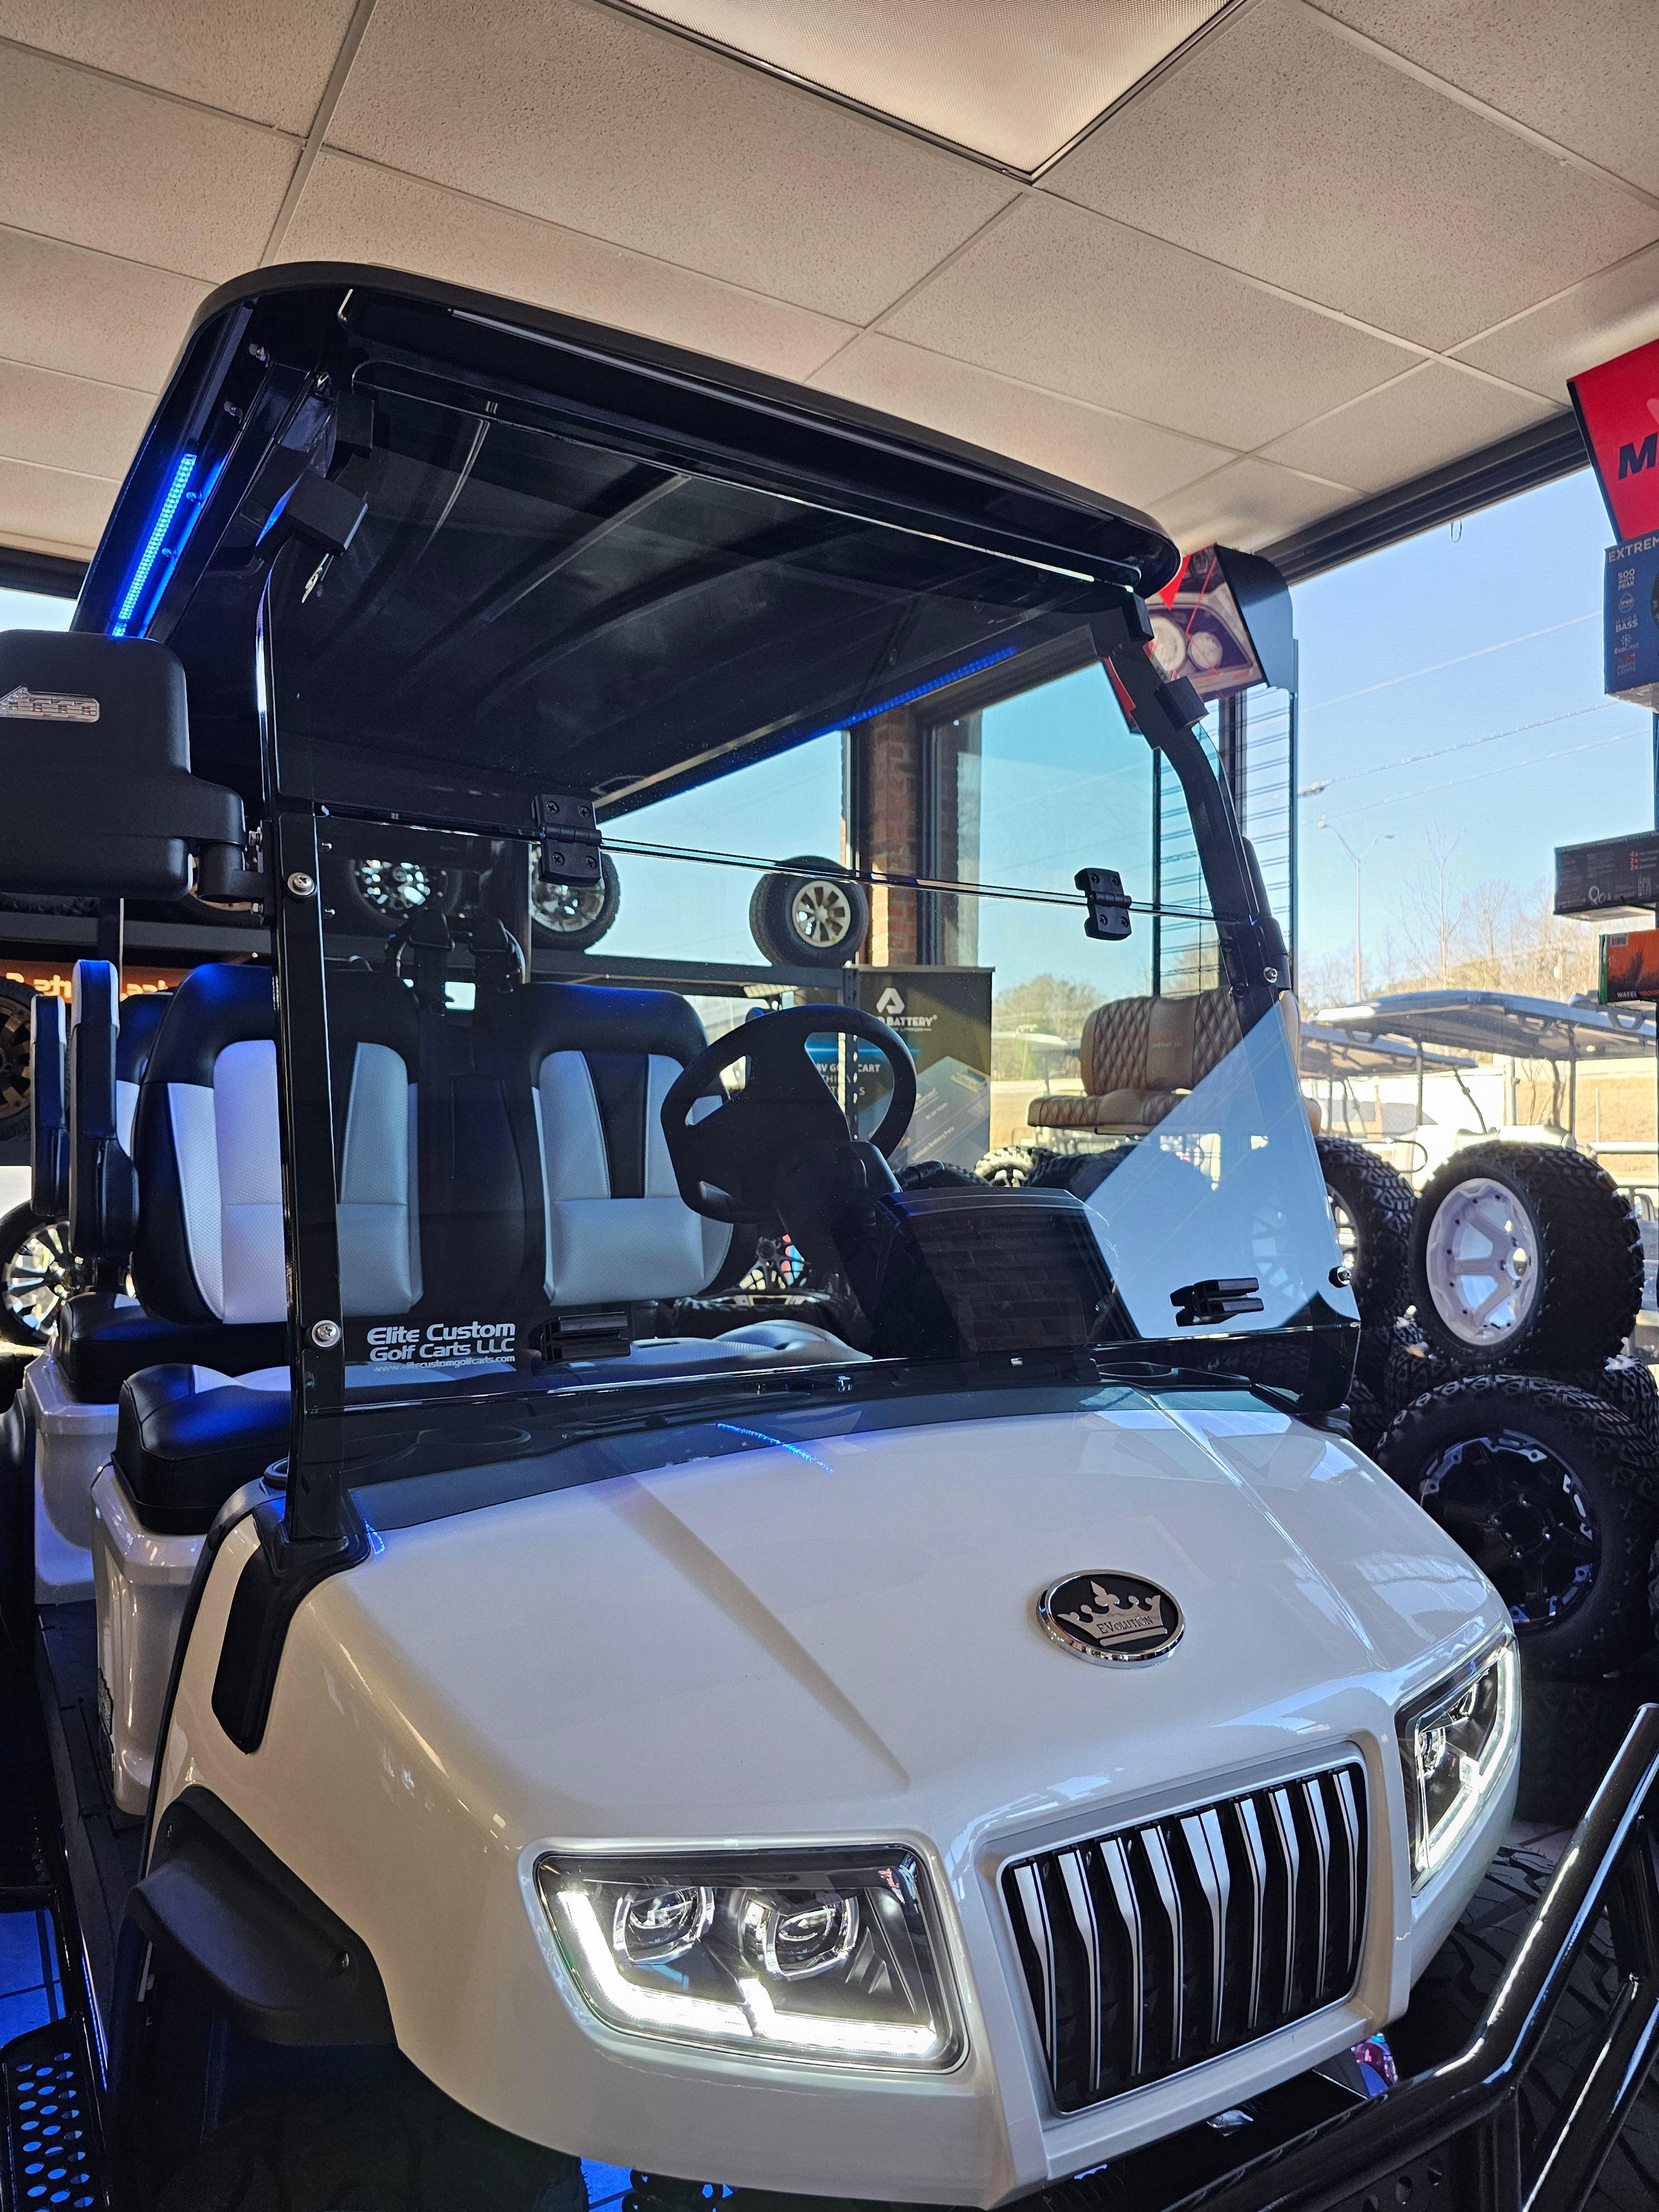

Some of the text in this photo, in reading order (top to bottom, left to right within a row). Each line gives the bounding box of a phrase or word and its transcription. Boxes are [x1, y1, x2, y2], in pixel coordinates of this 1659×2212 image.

[1615, 620, 1638, 633] BASS
[886, 1016, 933, 1026] BATTERY
[367, 1321, 515, 1345] Elite Custom
[369, 1338, 515, 1361] Golf Carts LLC
[1096, 1616, 1154, 1634] EVOLUTION
